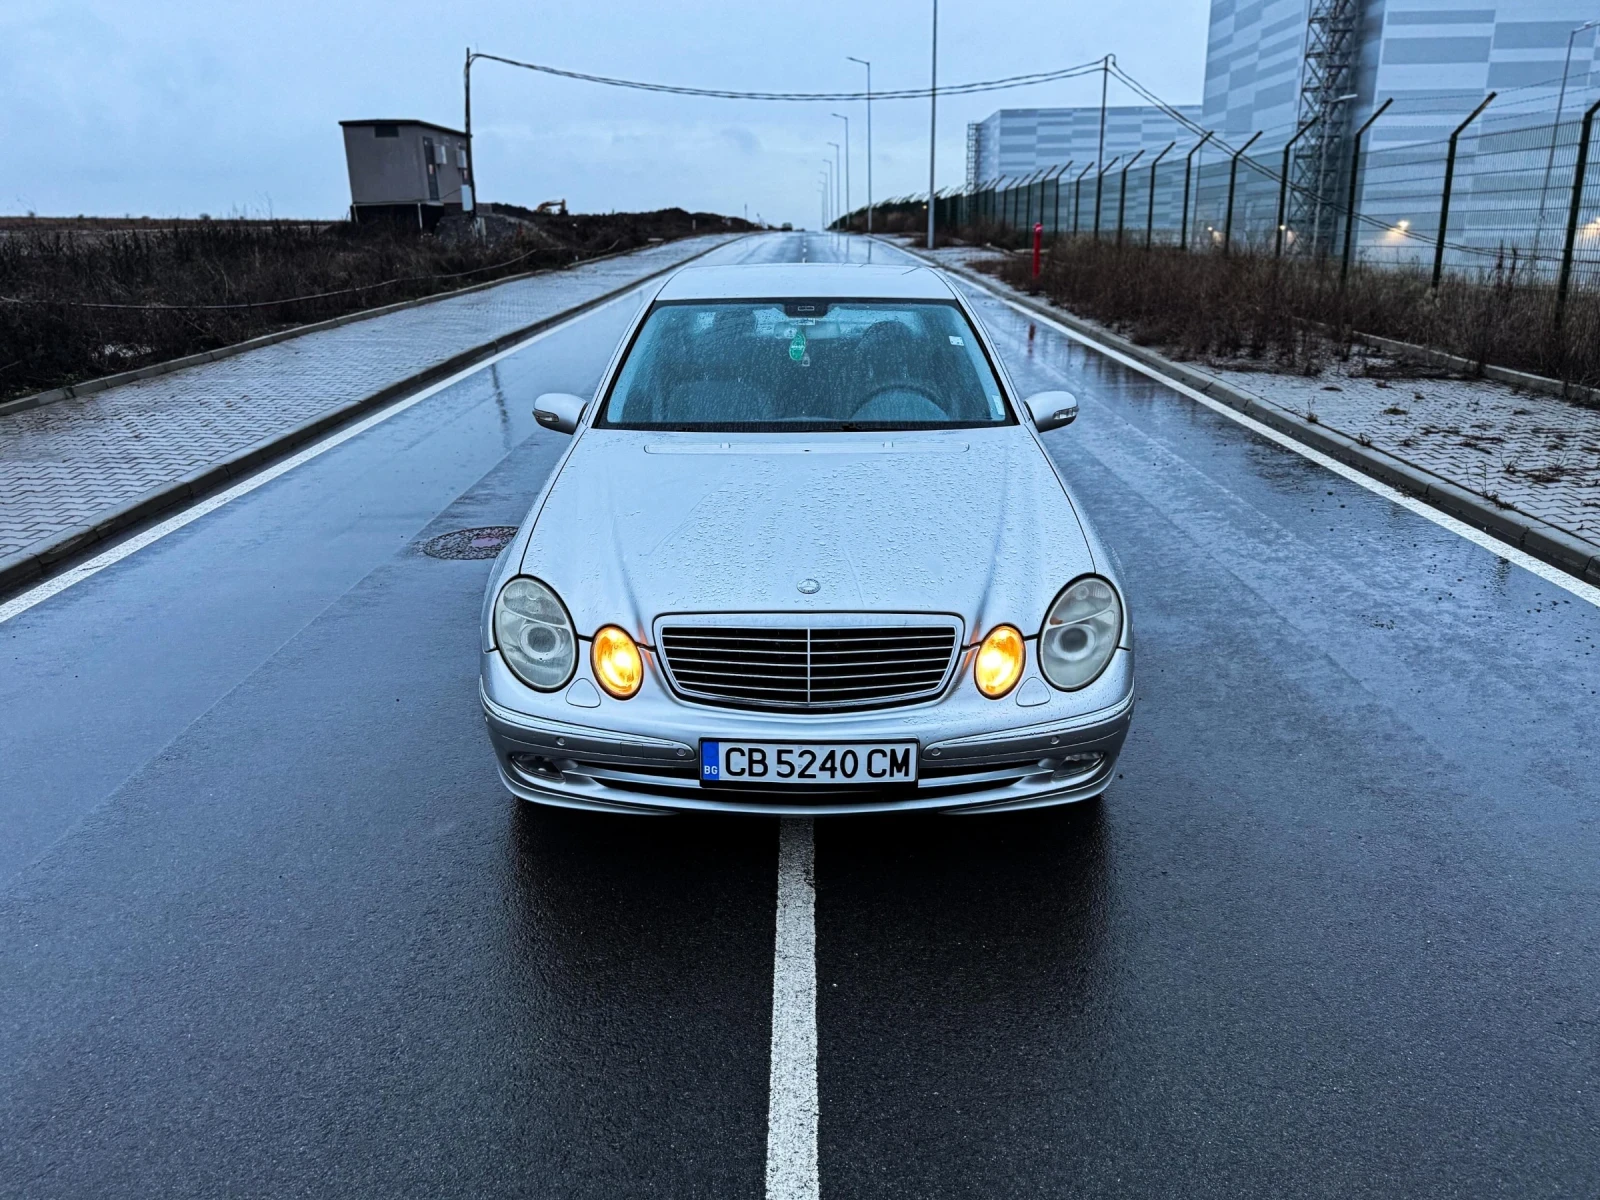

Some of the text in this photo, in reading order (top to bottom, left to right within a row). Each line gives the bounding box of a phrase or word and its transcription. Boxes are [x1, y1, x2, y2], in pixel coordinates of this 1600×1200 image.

[704, 765, 718, 775] BG
[725, 747, 910, 779] CB 5240 CM
